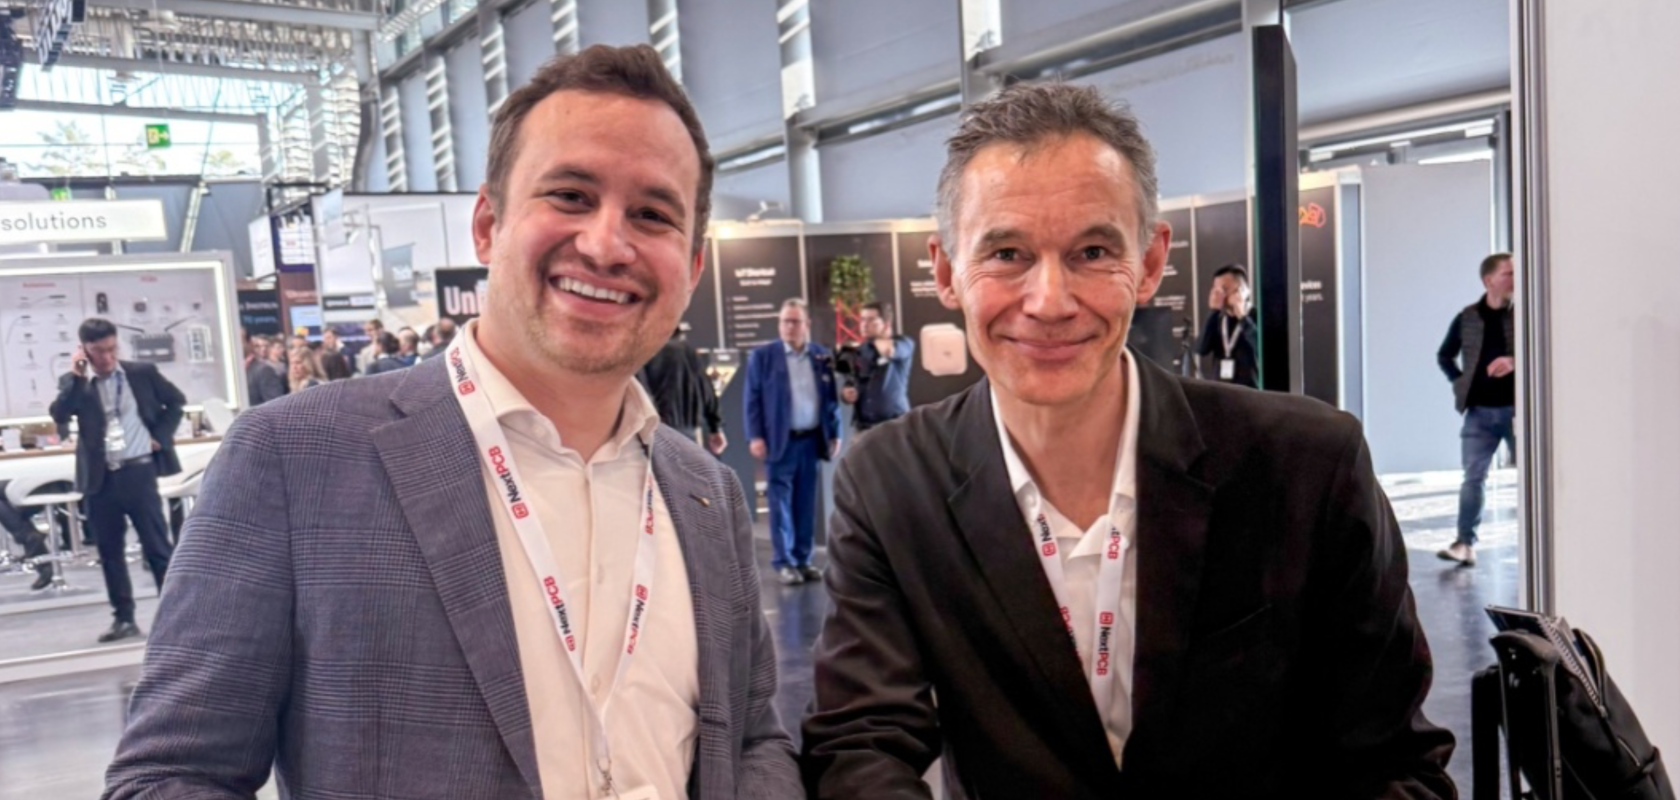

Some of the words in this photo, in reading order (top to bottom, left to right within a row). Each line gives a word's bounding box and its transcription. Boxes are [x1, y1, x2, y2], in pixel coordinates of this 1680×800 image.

[1, 211, 107, 231] solutions
[489, 446, 522, 503] NextPCB
[544, 576, 570, 635] NextPCB
[627, 600, 645, 655] NextPCB
[1096, 626, 1112, 676] NextPCB
